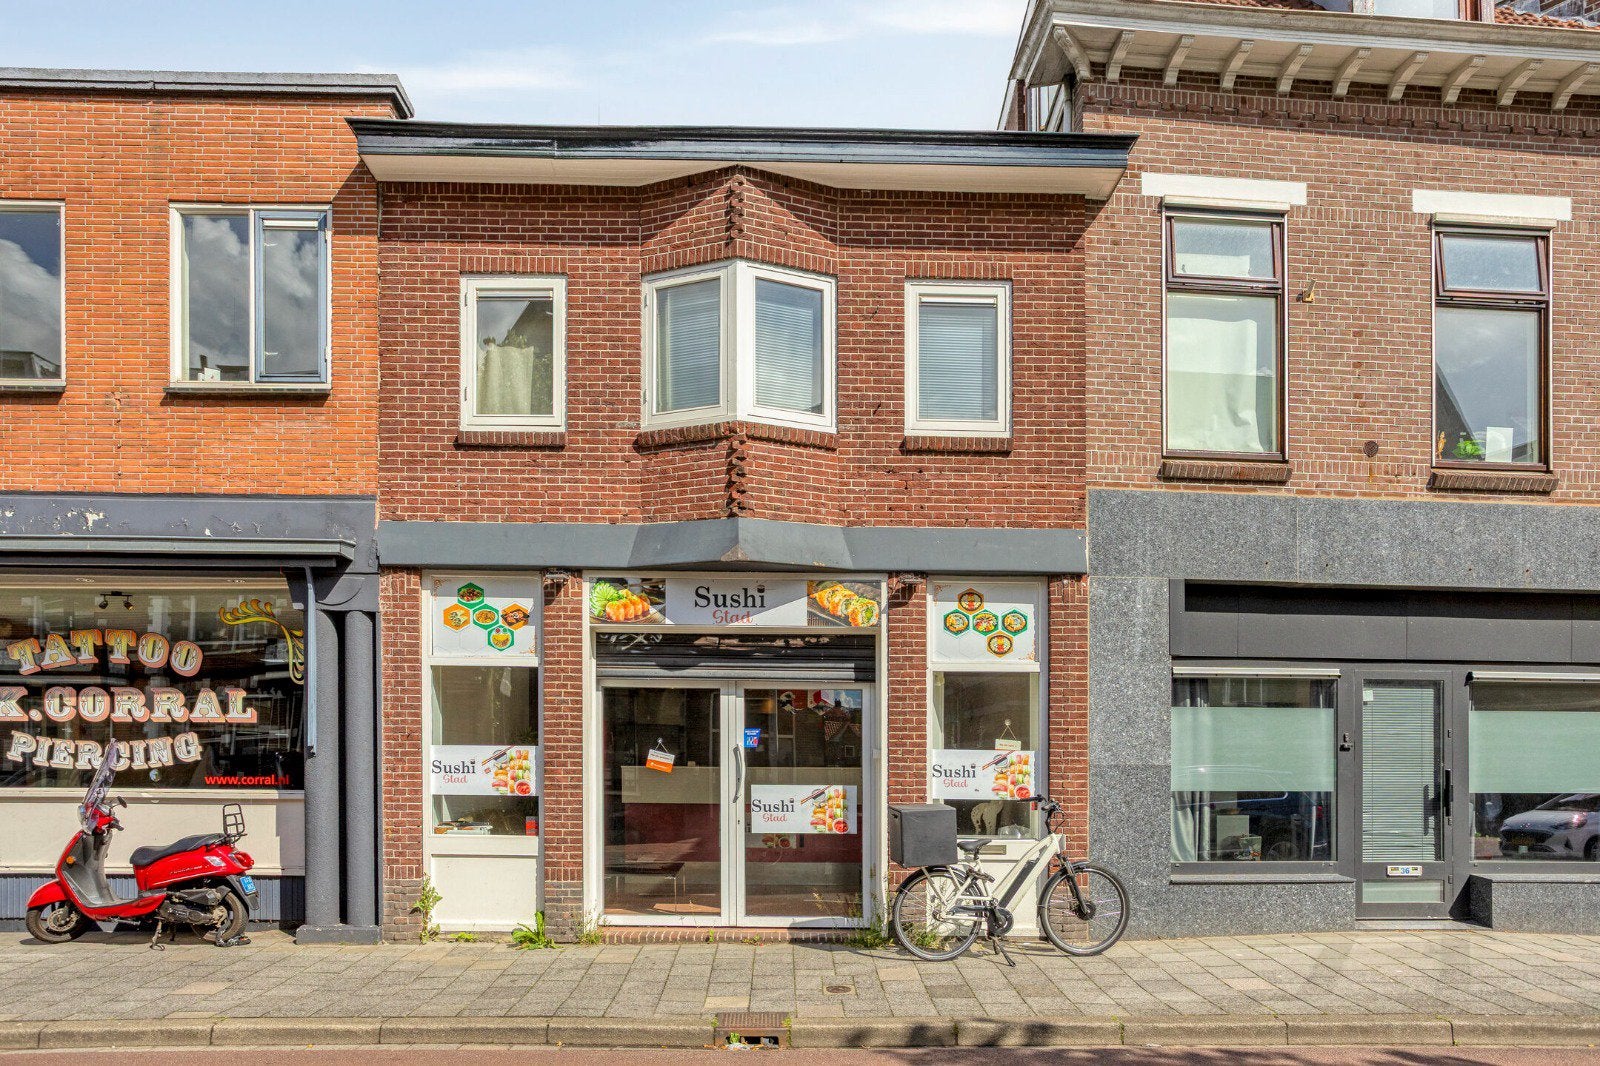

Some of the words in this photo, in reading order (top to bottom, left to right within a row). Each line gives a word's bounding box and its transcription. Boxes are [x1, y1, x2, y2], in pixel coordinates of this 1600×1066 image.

[694, 585, 767, 608] Sushi
[6, 629, 203, 677] TATTOO
[6, 730, 203, 772] PIERCING
[431, 759, 476, 774] Sushi
[932, 763, 977, 778] Sushi
[204, 774, 289, 785] www.corral.nl
[751, 798, 795, 812] Sushi
[1400, 867, 1410, 875] 36
